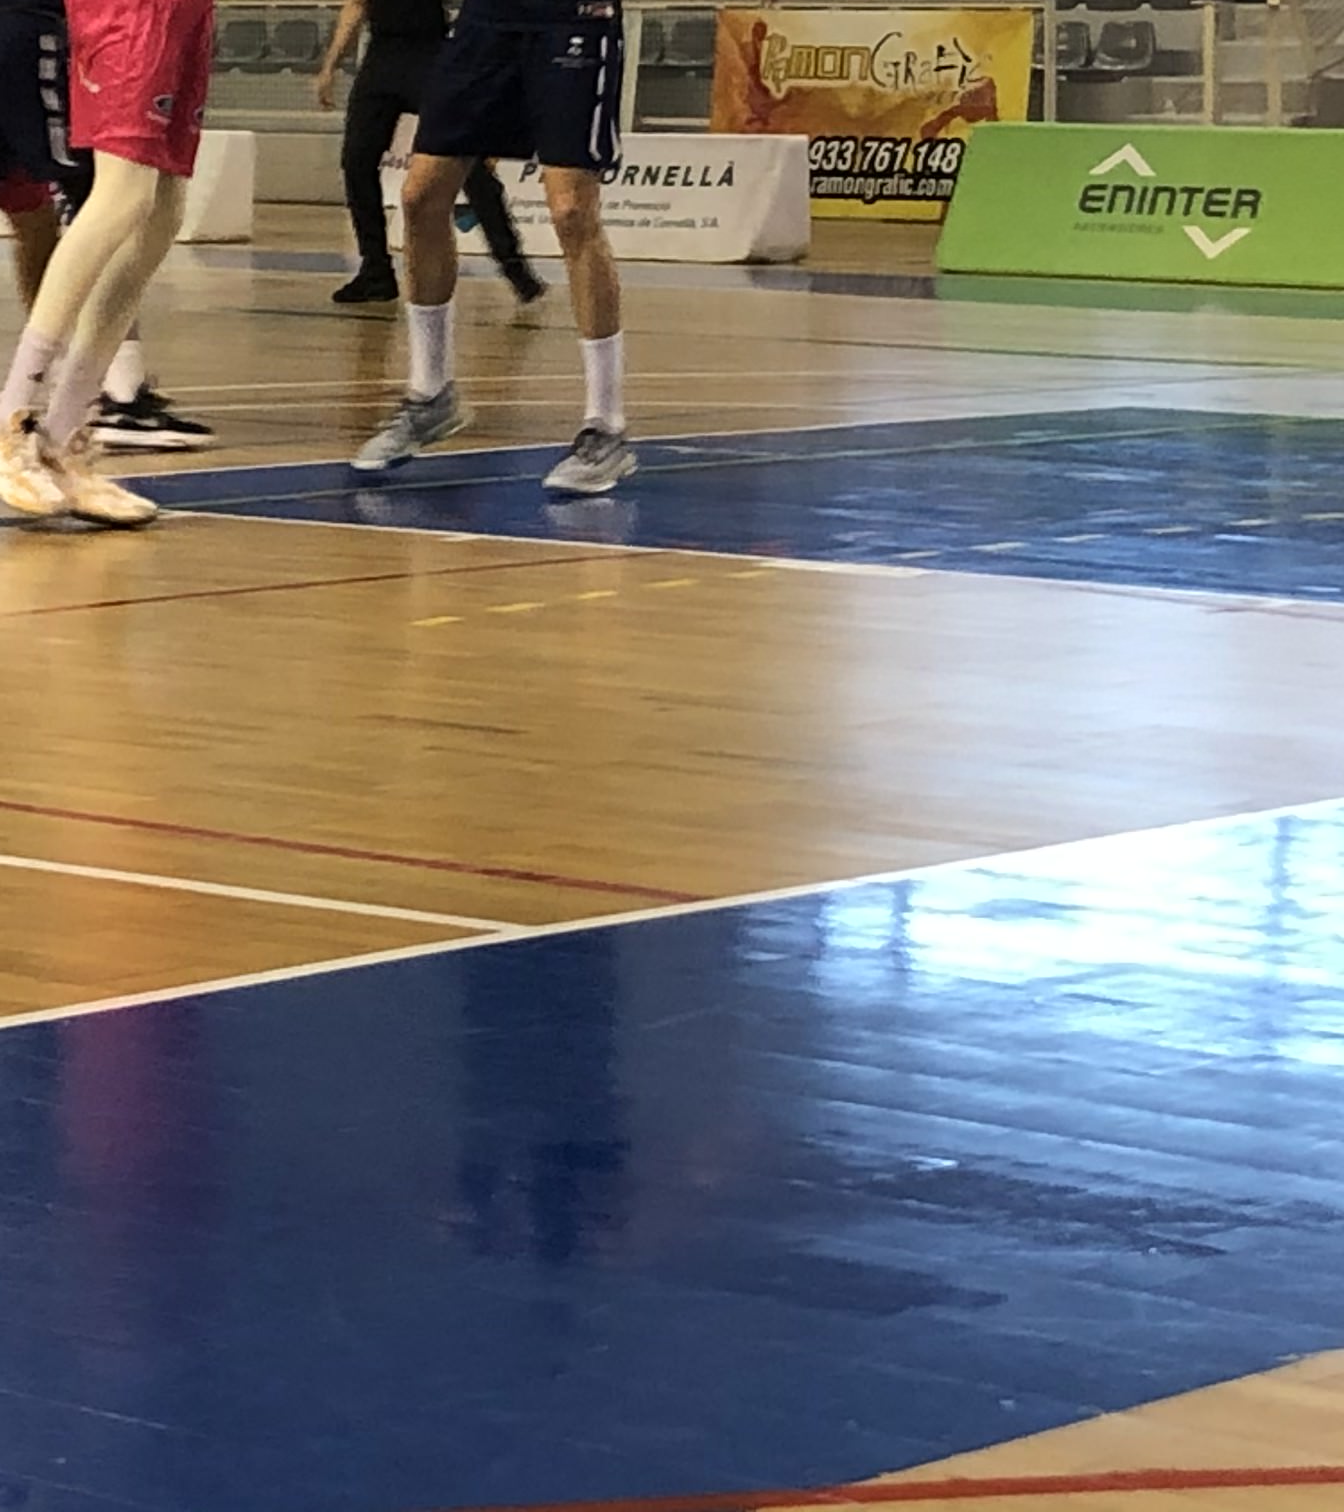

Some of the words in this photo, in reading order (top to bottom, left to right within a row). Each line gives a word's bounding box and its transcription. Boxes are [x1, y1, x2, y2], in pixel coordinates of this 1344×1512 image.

[808, 140, 857, 172] 933
[862, 141, 907, 173] 761
[916, 142, 961, 174] 148
[809, 174, 955, 200] ramongrafic.com
[1078, 183, 1263, 220] ENINTER
